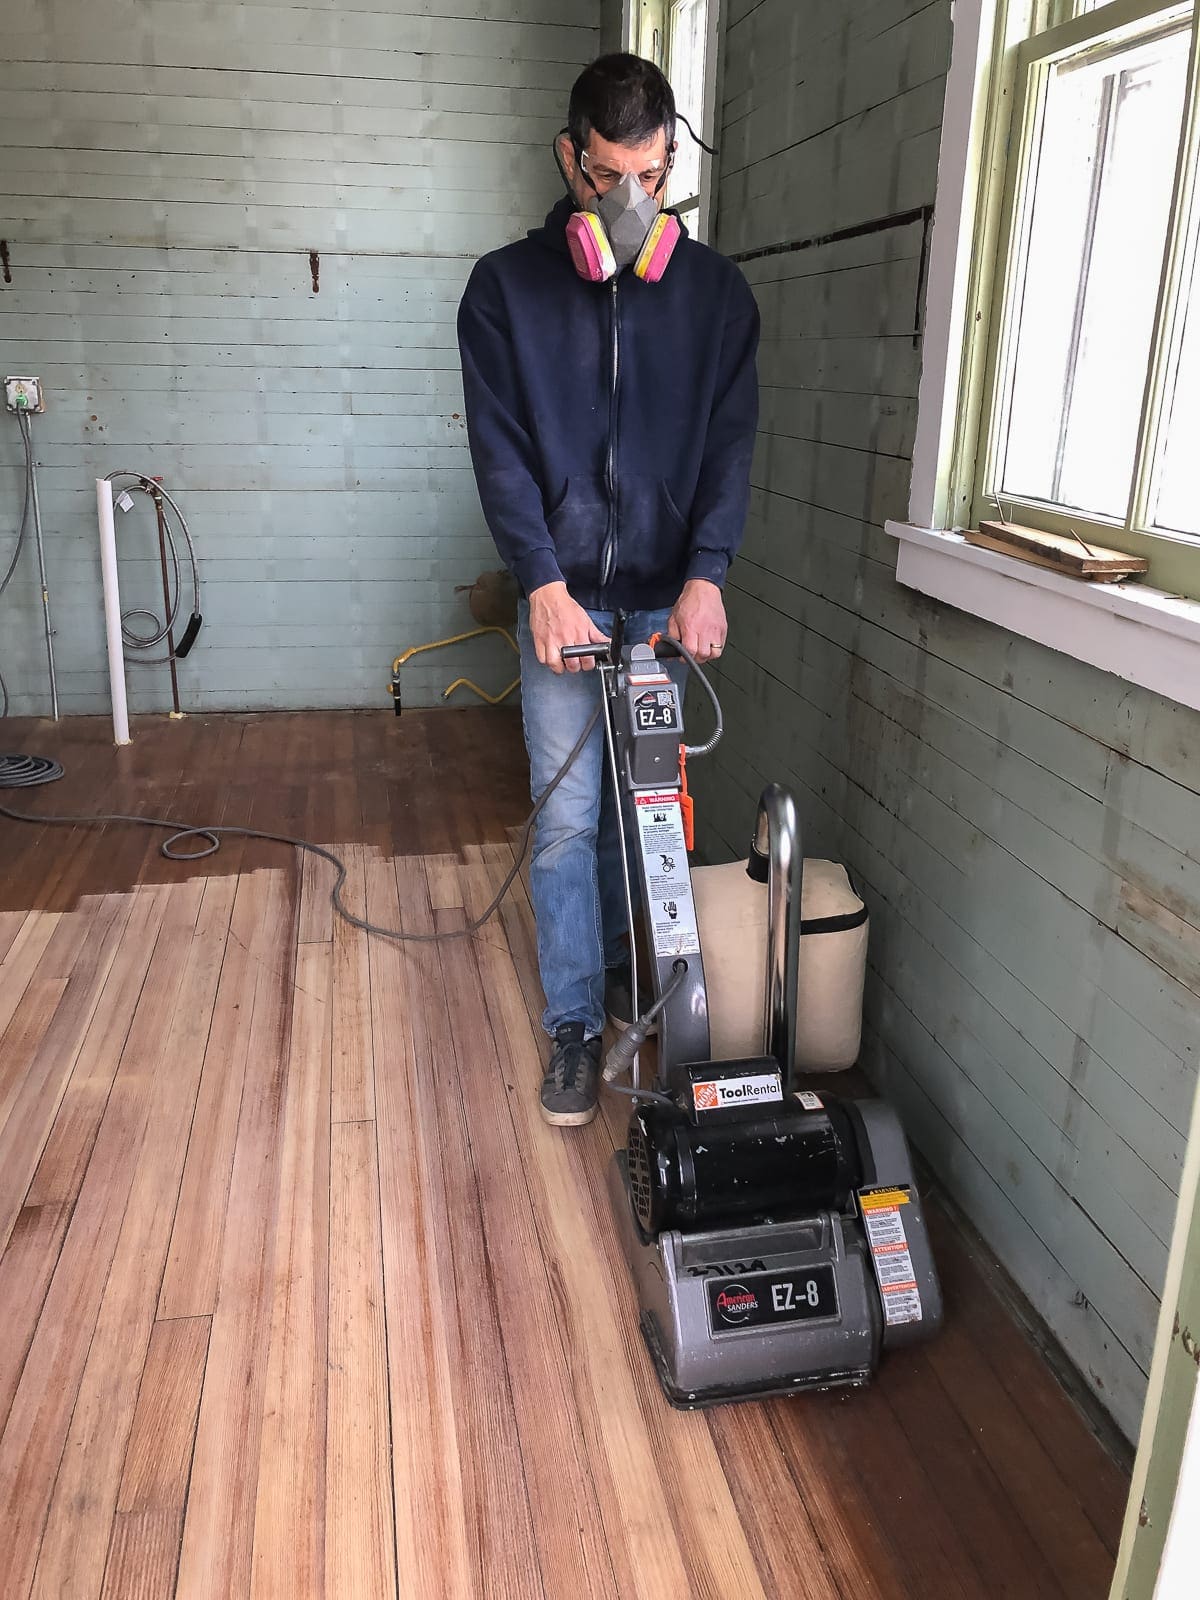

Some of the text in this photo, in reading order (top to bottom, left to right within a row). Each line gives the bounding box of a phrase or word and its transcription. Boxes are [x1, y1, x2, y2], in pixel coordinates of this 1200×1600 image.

[639, 708, 672, 726] EZ-8
[717, 1292, 755, 1308] American
[771, 1280, 819, 1312] EZ-8
[727, 1301, 759, 1312] SANDERS
